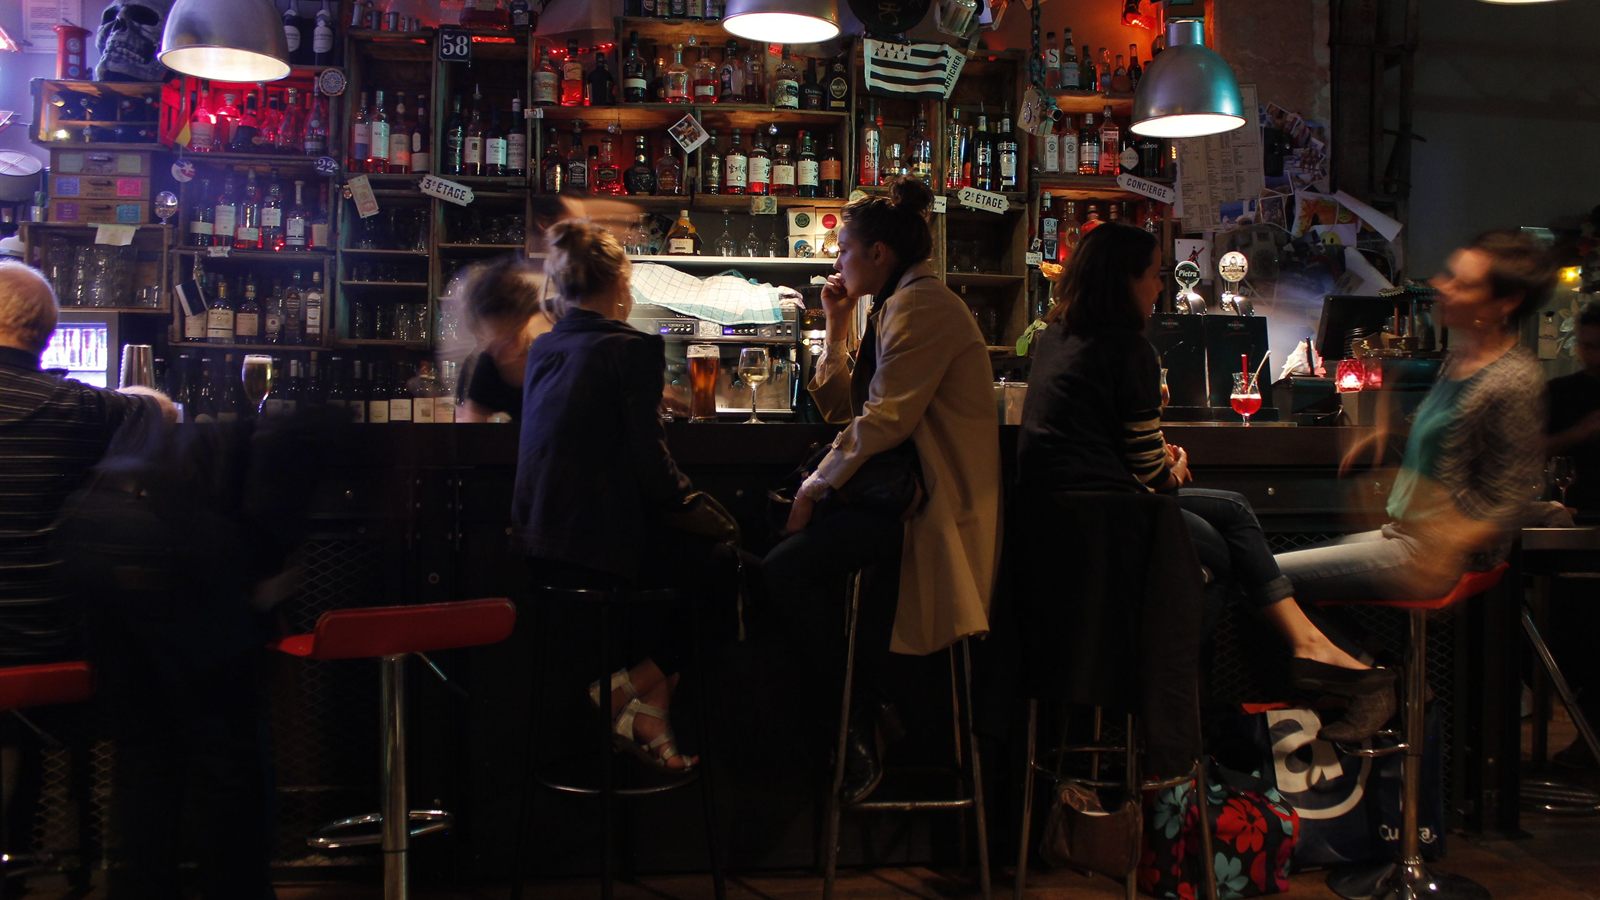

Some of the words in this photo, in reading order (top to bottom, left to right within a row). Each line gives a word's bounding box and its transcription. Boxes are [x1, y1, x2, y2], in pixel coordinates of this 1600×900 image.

[442, 34, 468, 56] 58
[1049, 49, 1058, 63] S
[316, 158, 336, 173] 22
[1126, 178, 1167, 198] CONCIERGE
[976, 192, 1003, 209] ÉTAGE
[1178, 269, 1198, 277] Pietra
